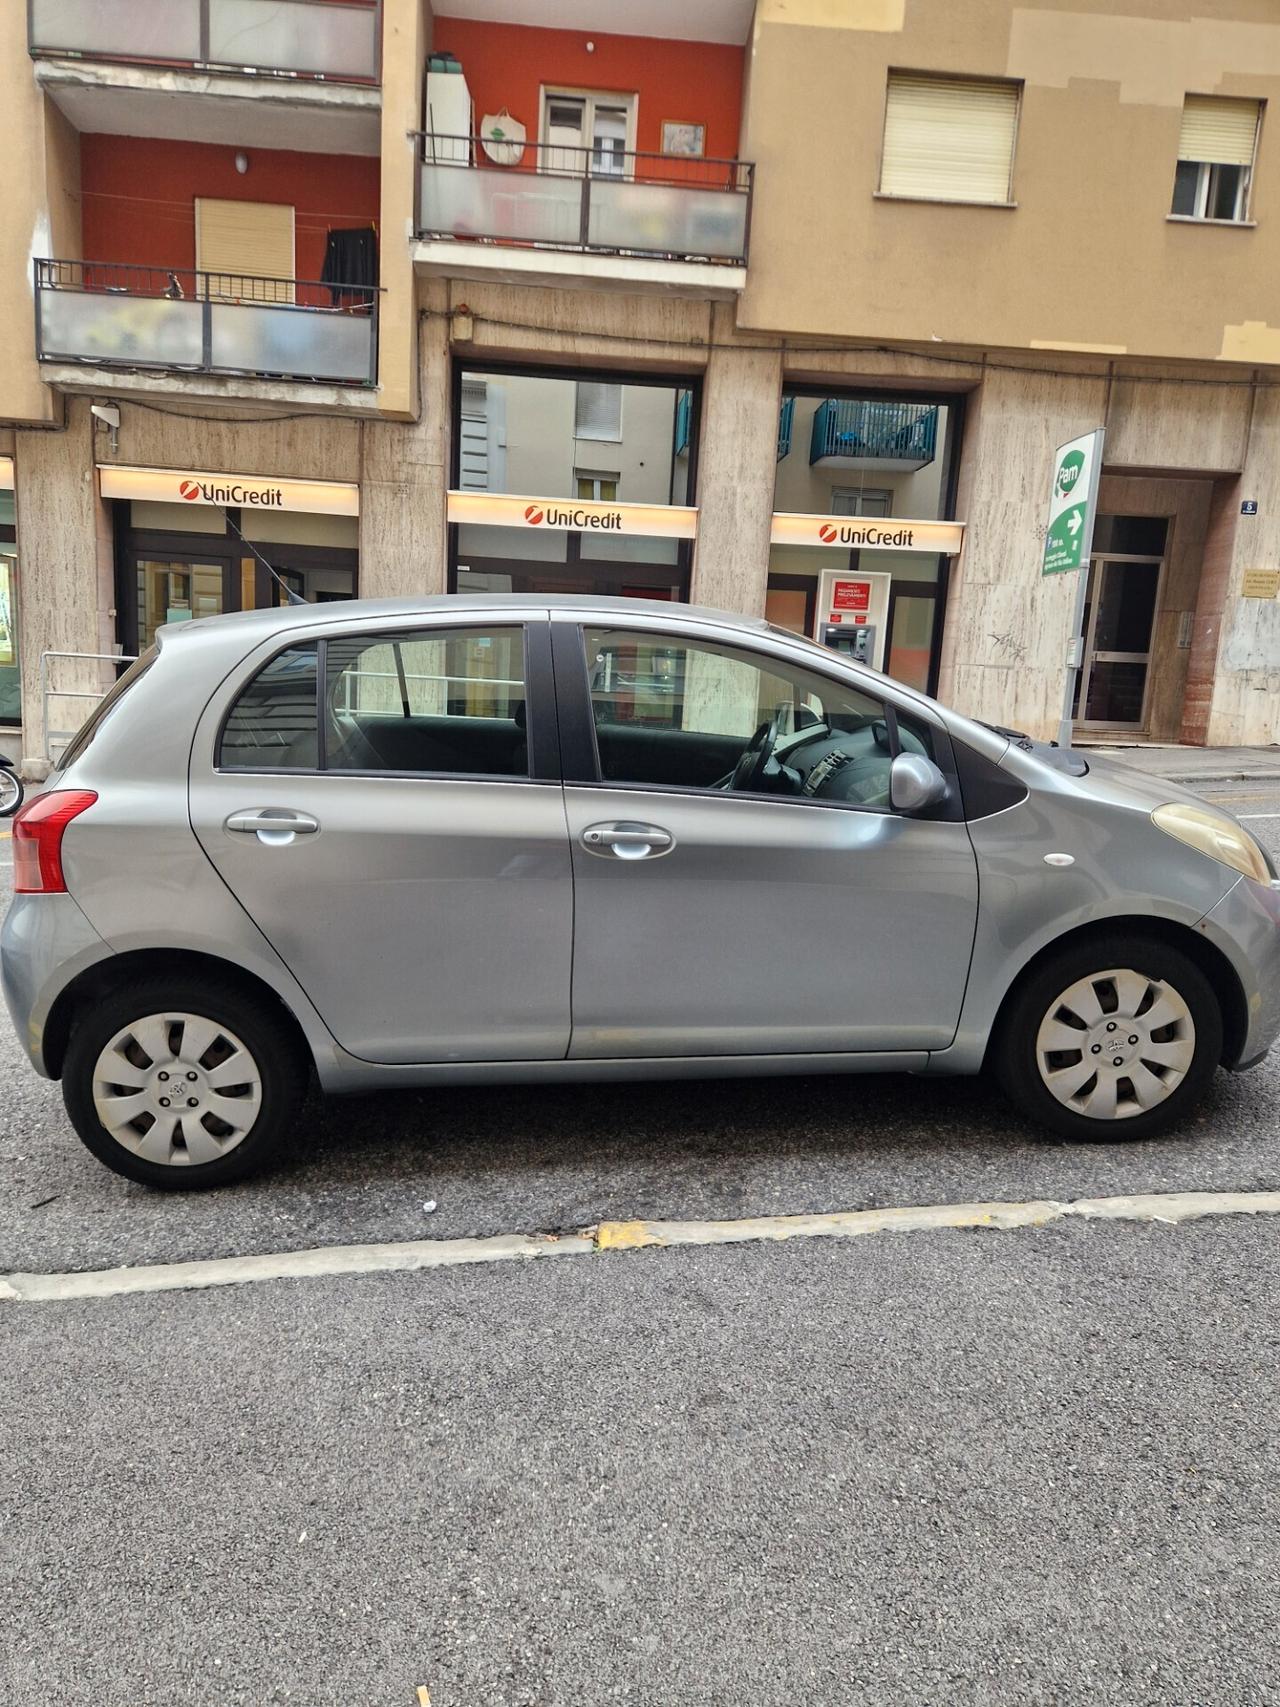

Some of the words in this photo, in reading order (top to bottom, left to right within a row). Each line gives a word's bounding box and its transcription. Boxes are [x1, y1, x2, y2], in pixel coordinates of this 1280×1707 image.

[1058, 464, 1079, 484] Pam
[203, 484, 282, 506] UniCredit
[1246, 502, 1253, 511] 5
[546, 509, 622, 530] UniCredit
[840, 526, 914, 548] UniCredit
